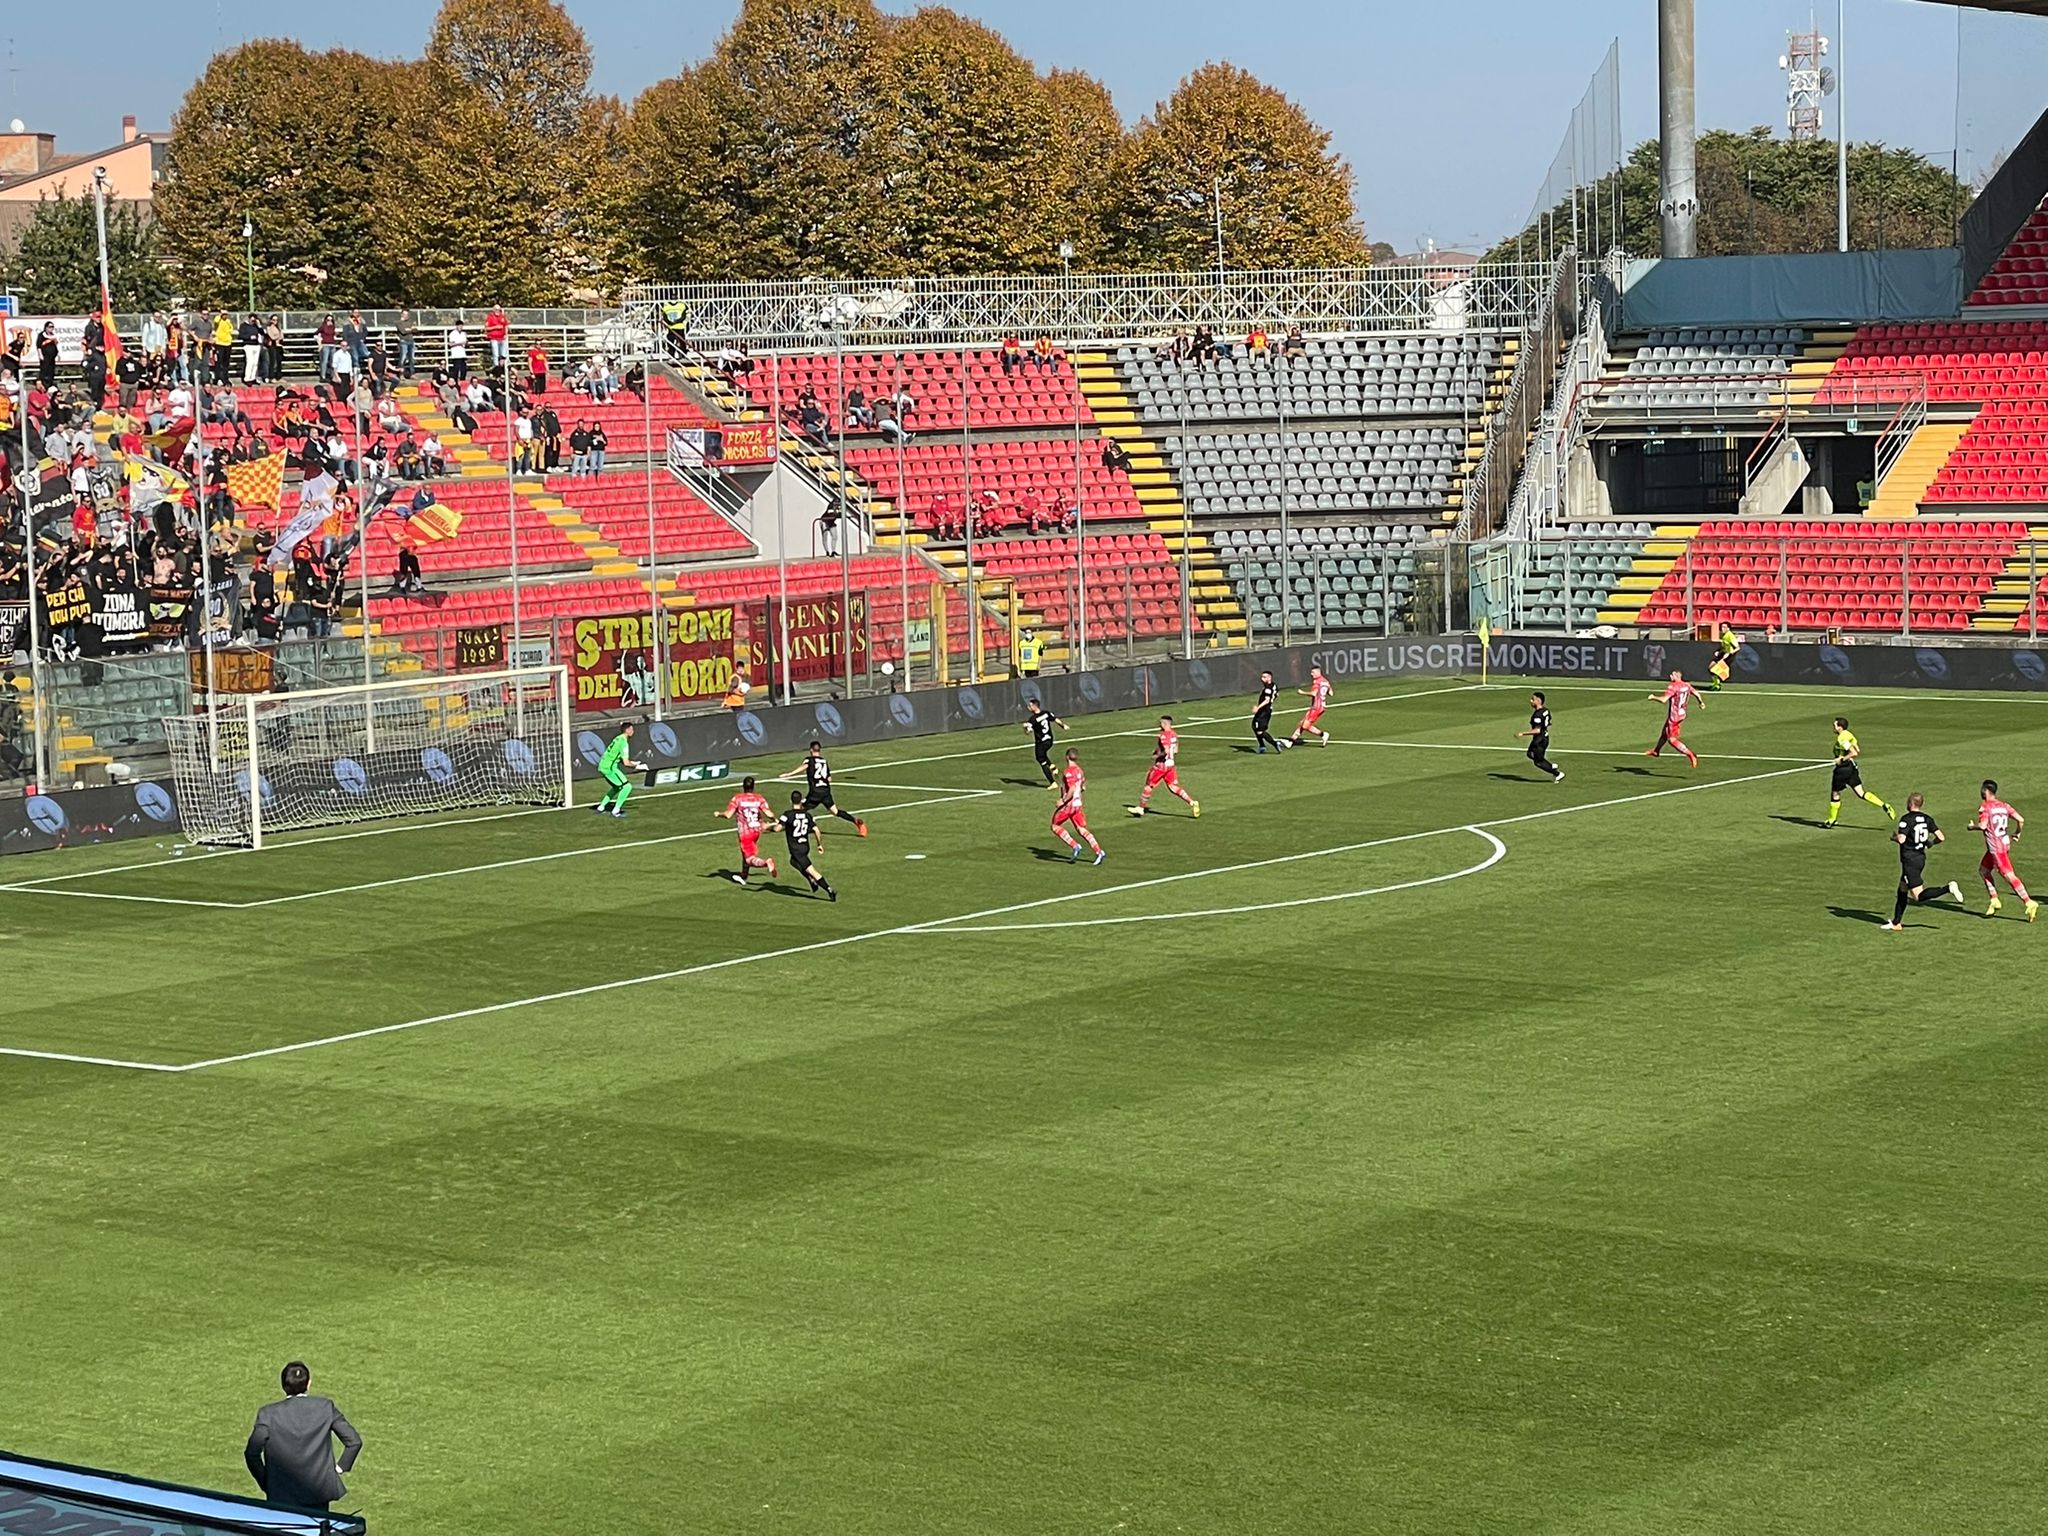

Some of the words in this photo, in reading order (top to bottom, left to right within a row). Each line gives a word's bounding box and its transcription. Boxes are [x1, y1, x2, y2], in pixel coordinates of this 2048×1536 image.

[727, 430, 762, 445] FORZA
[46, 591, 67, 608] PER
[68, 587, 86, 602] CHI
[103, 593, 136, 613] ZONA
[779, 600, 840, 630] GENS
[462, 645, 496, 663] 1998
[1311, 643, 1629, 675] STORE.USCREMONESE.IT
[577, 673, 623, 701] DEL
[657, 656, 733, 699] NORD
[656, 764, 727, 784] BKT
[814, 763, 827, 779] 24
[792, 819, 809, 837] 25
[1914, 823, 1929, 844] 15
